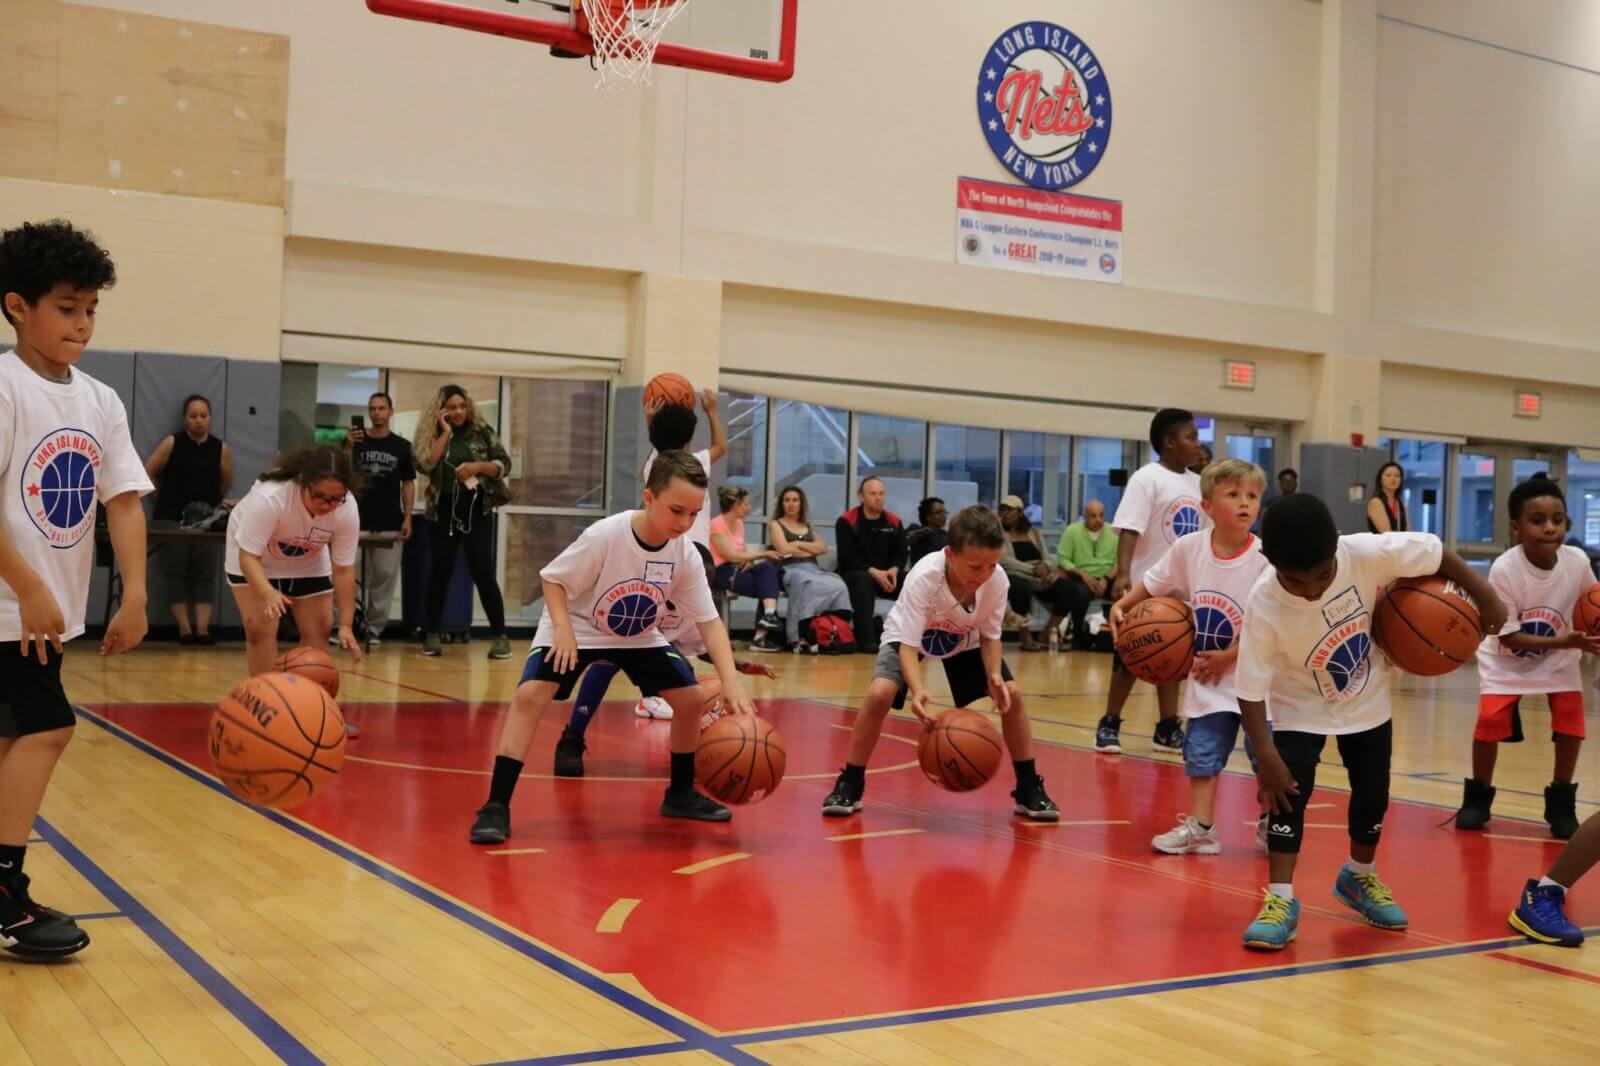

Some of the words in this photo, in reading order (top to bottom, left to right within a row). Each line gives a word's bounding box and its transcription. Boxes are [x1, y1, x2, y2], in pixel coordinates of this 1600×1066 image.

[995, 26, 1036, 63] LONG
[1044, 27, 1099, 80] ISLAND
[995, 69, 1095, 140] Nets
[1003, 145, 1038, 180] NEW
[1043, 158, 1083, 185] YORK
[960, 217, 974, 229] NBA
[981, 220, 1003, 234] League
[1004, 223, 1028, 237] Eastern
[1028, 227, 1063, 241] Conference
[1008, 241, 1038, 260] GREAT
[33, 441, 57, 470] LONG
[57, 434, 87, 450] ISLND
[1311, 650, 1330, 673] LONG
[1326, 622, 1358, 649] ISLAND
